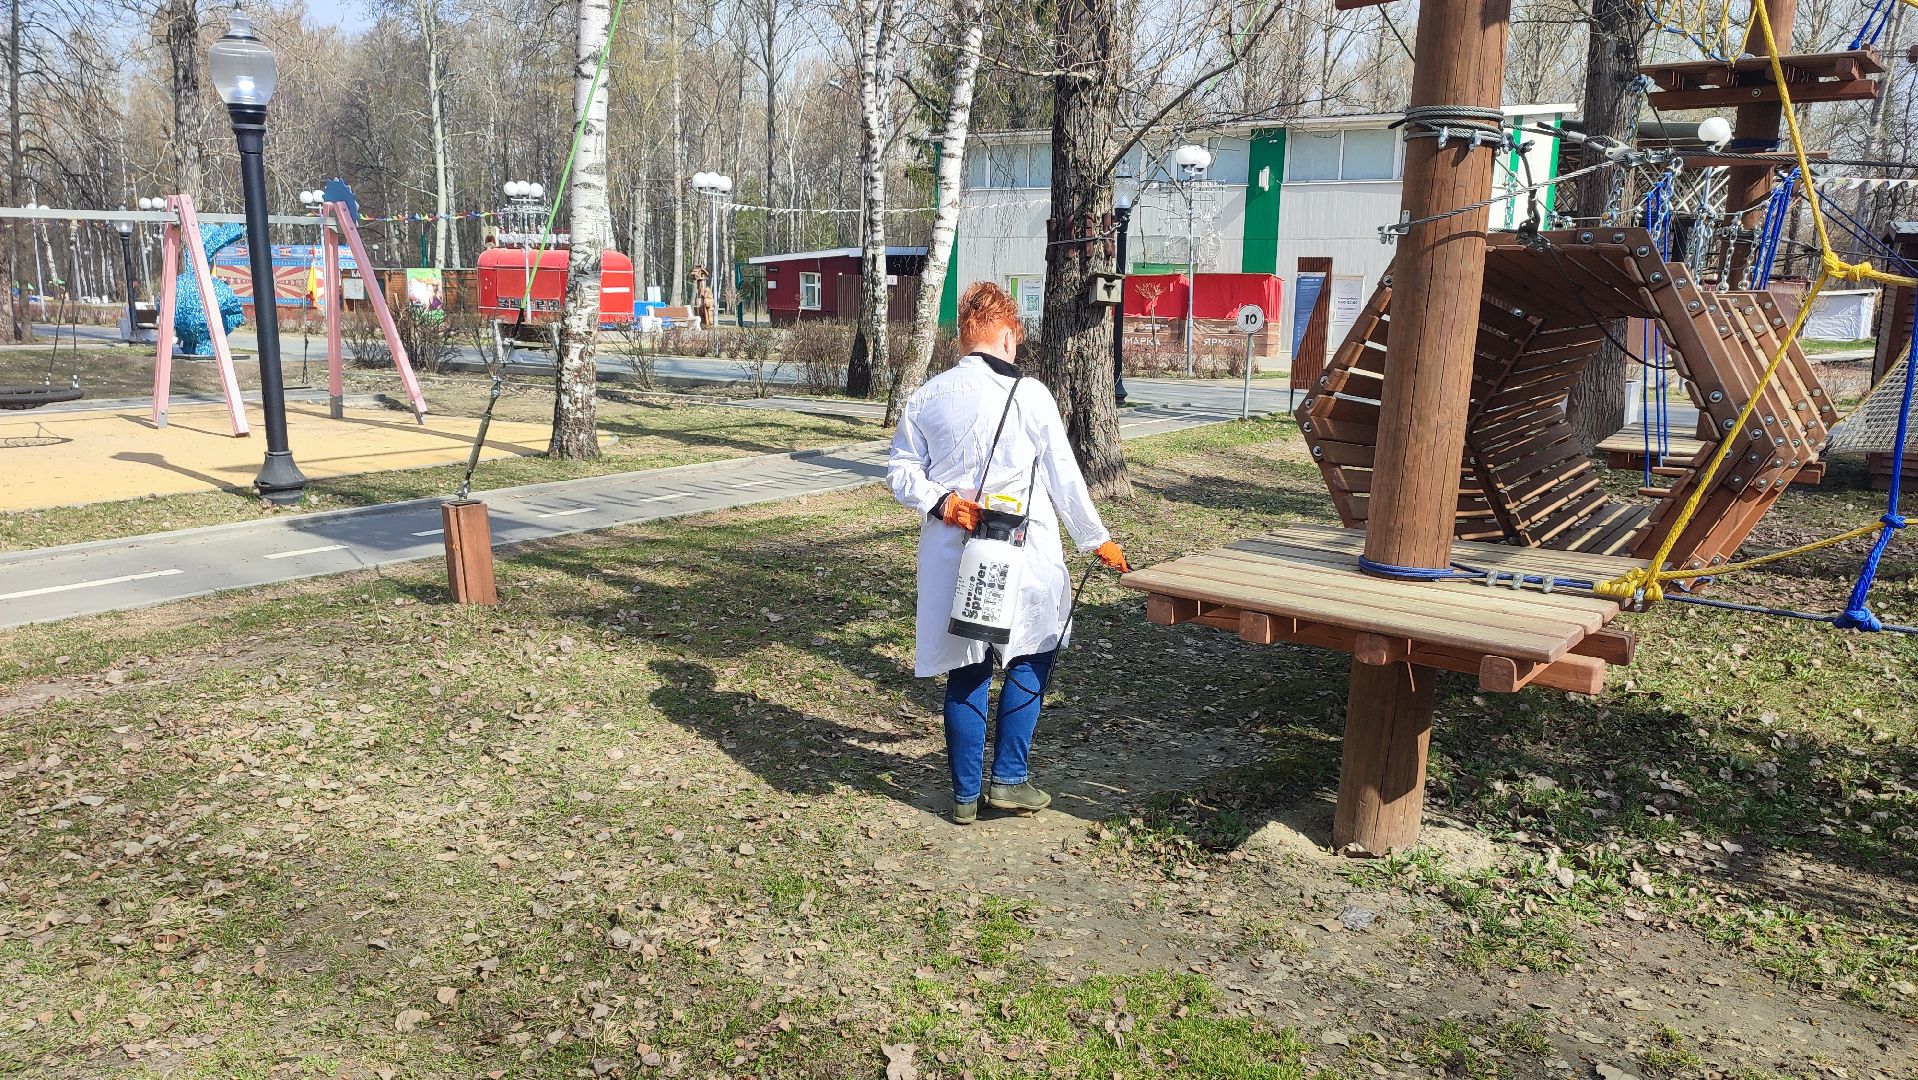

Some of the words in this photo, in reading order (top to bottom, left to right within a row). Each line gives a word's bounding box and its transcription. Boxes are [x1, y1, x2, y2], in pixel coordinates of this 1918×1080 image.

[1245, 314, 1257, 324] 10
[1124, 336, 1160, 347] МАРКА
[968, 563, 987, 619] Sprayer
